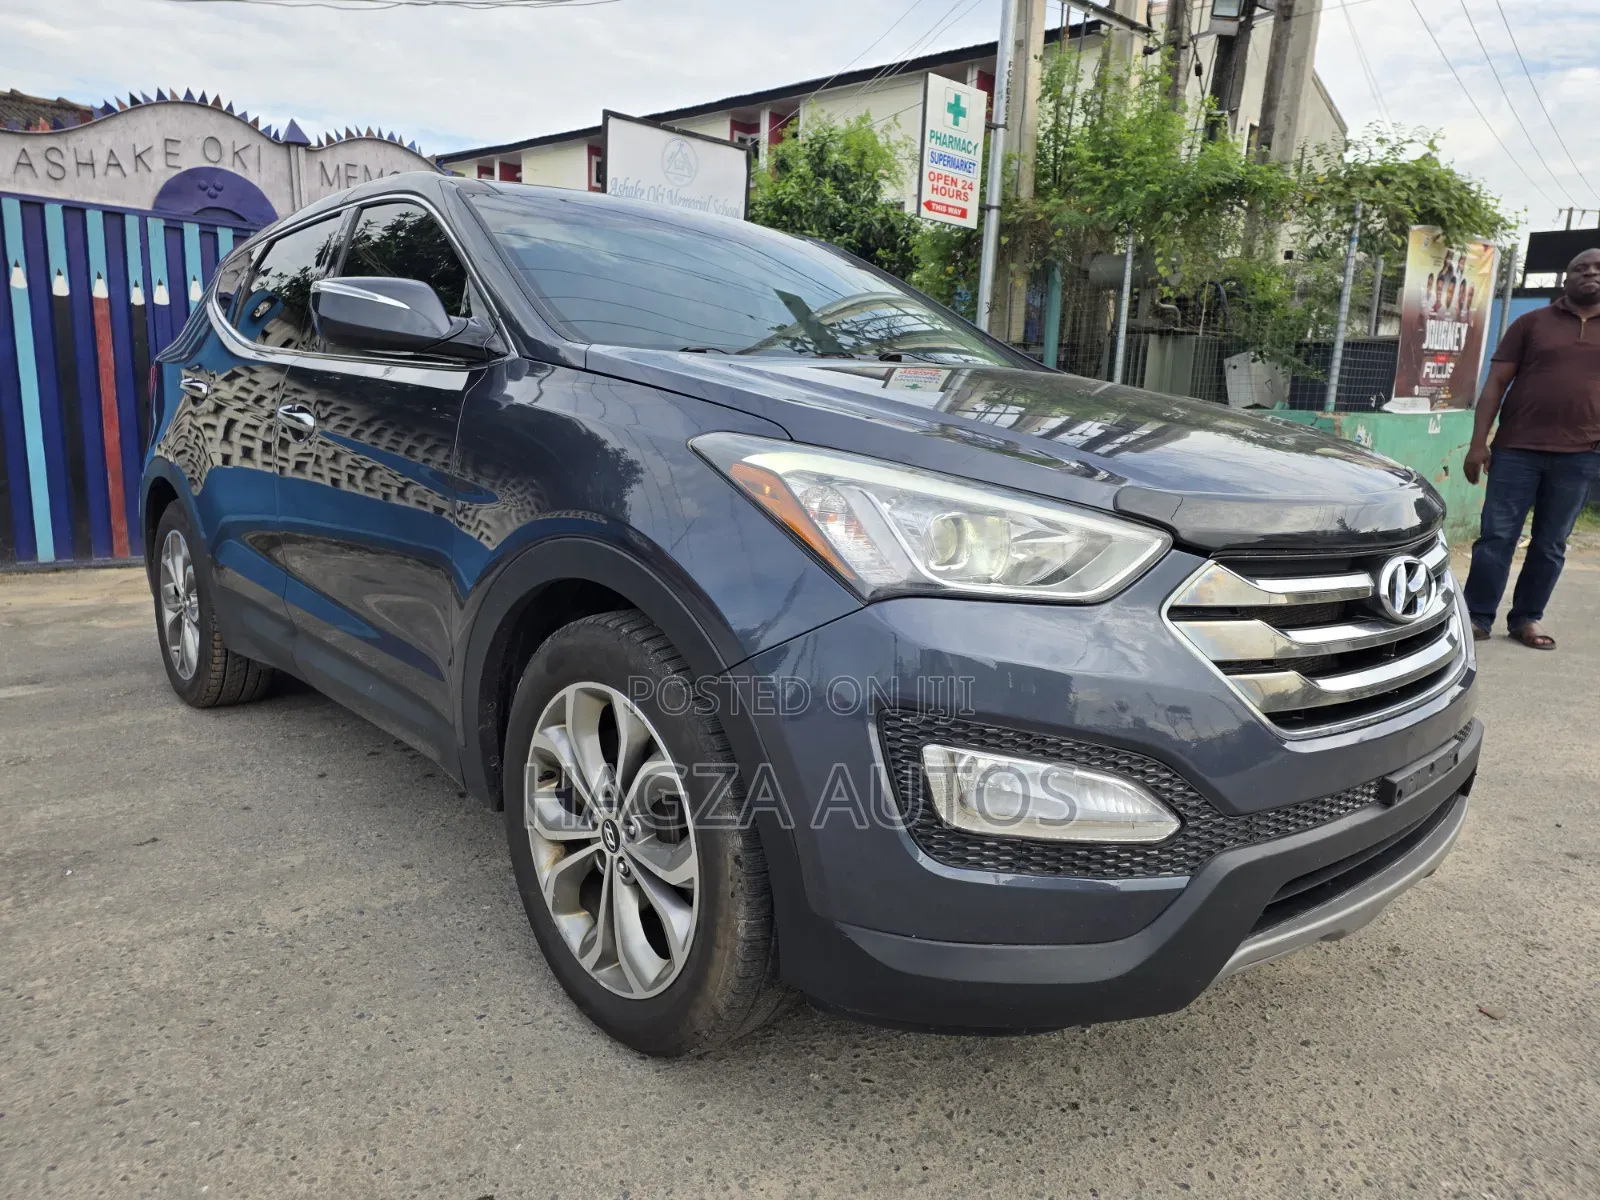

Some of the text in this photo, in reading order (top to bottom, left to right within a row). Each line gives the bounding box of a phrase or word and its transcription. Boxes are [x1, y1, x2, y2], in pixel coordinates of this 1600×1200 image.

[13, 135, 262, 181] ASHAKE OKI
[930, 151, 977, 175] SUPERMARKET
[319, 159, 401, 190] MEM
[928, 171, 974, 192] OPEN 24
[608, 176, 744, 220] Ashake Oki Memorial School
[931, 183, 970, 202] HOURS
[931, 202, 962, 216] THIS WAY
[1422, 319, 1469, 351] JOURNEY
[1422, 361, 1455, 379] FOCUS
